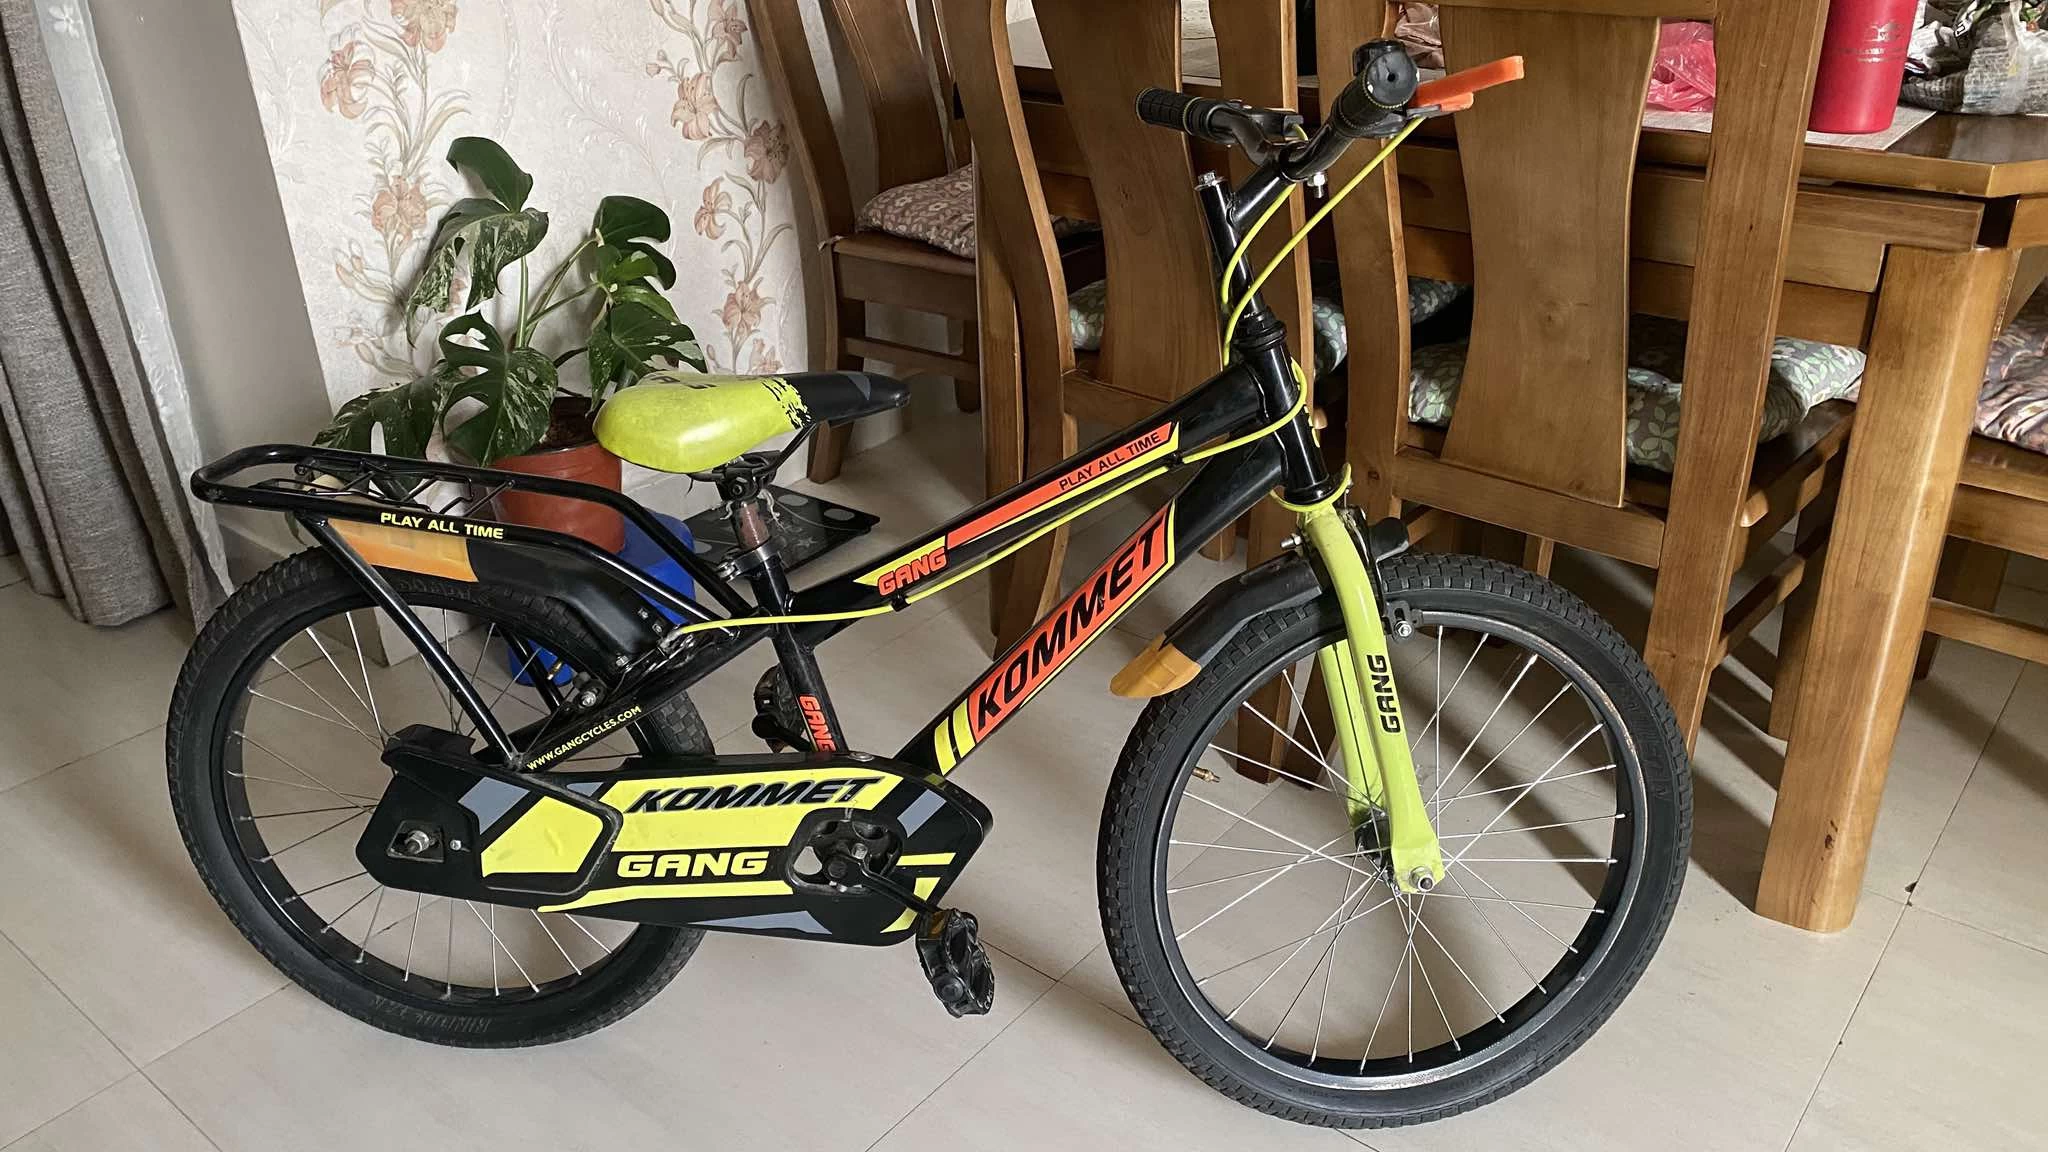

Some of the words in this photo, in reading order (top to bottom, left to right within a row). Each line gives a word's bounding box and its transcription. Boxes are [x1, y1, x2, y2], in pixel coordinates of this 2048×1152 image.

[1058, 465, 1093, 491] PLAY
[1099, 452, 1125, 472] ALL
[1126, 432, 1161, 456] TIME
[380, 512, 423, 529] PLAY
[428, 519, 459, 534] ALL
[464, 524, 504, 539] TIME
[877, 547, 948, 596] GANG
[978, 520, 1161, 732] KOMMET
[1366, 654, 1402, 734] GANG
[527, 705, 642, 770] WWW.GANGCYCLES.COM
[624, 776, 885, 814] KOMMET
[617, 851, 769, 879] GANG
